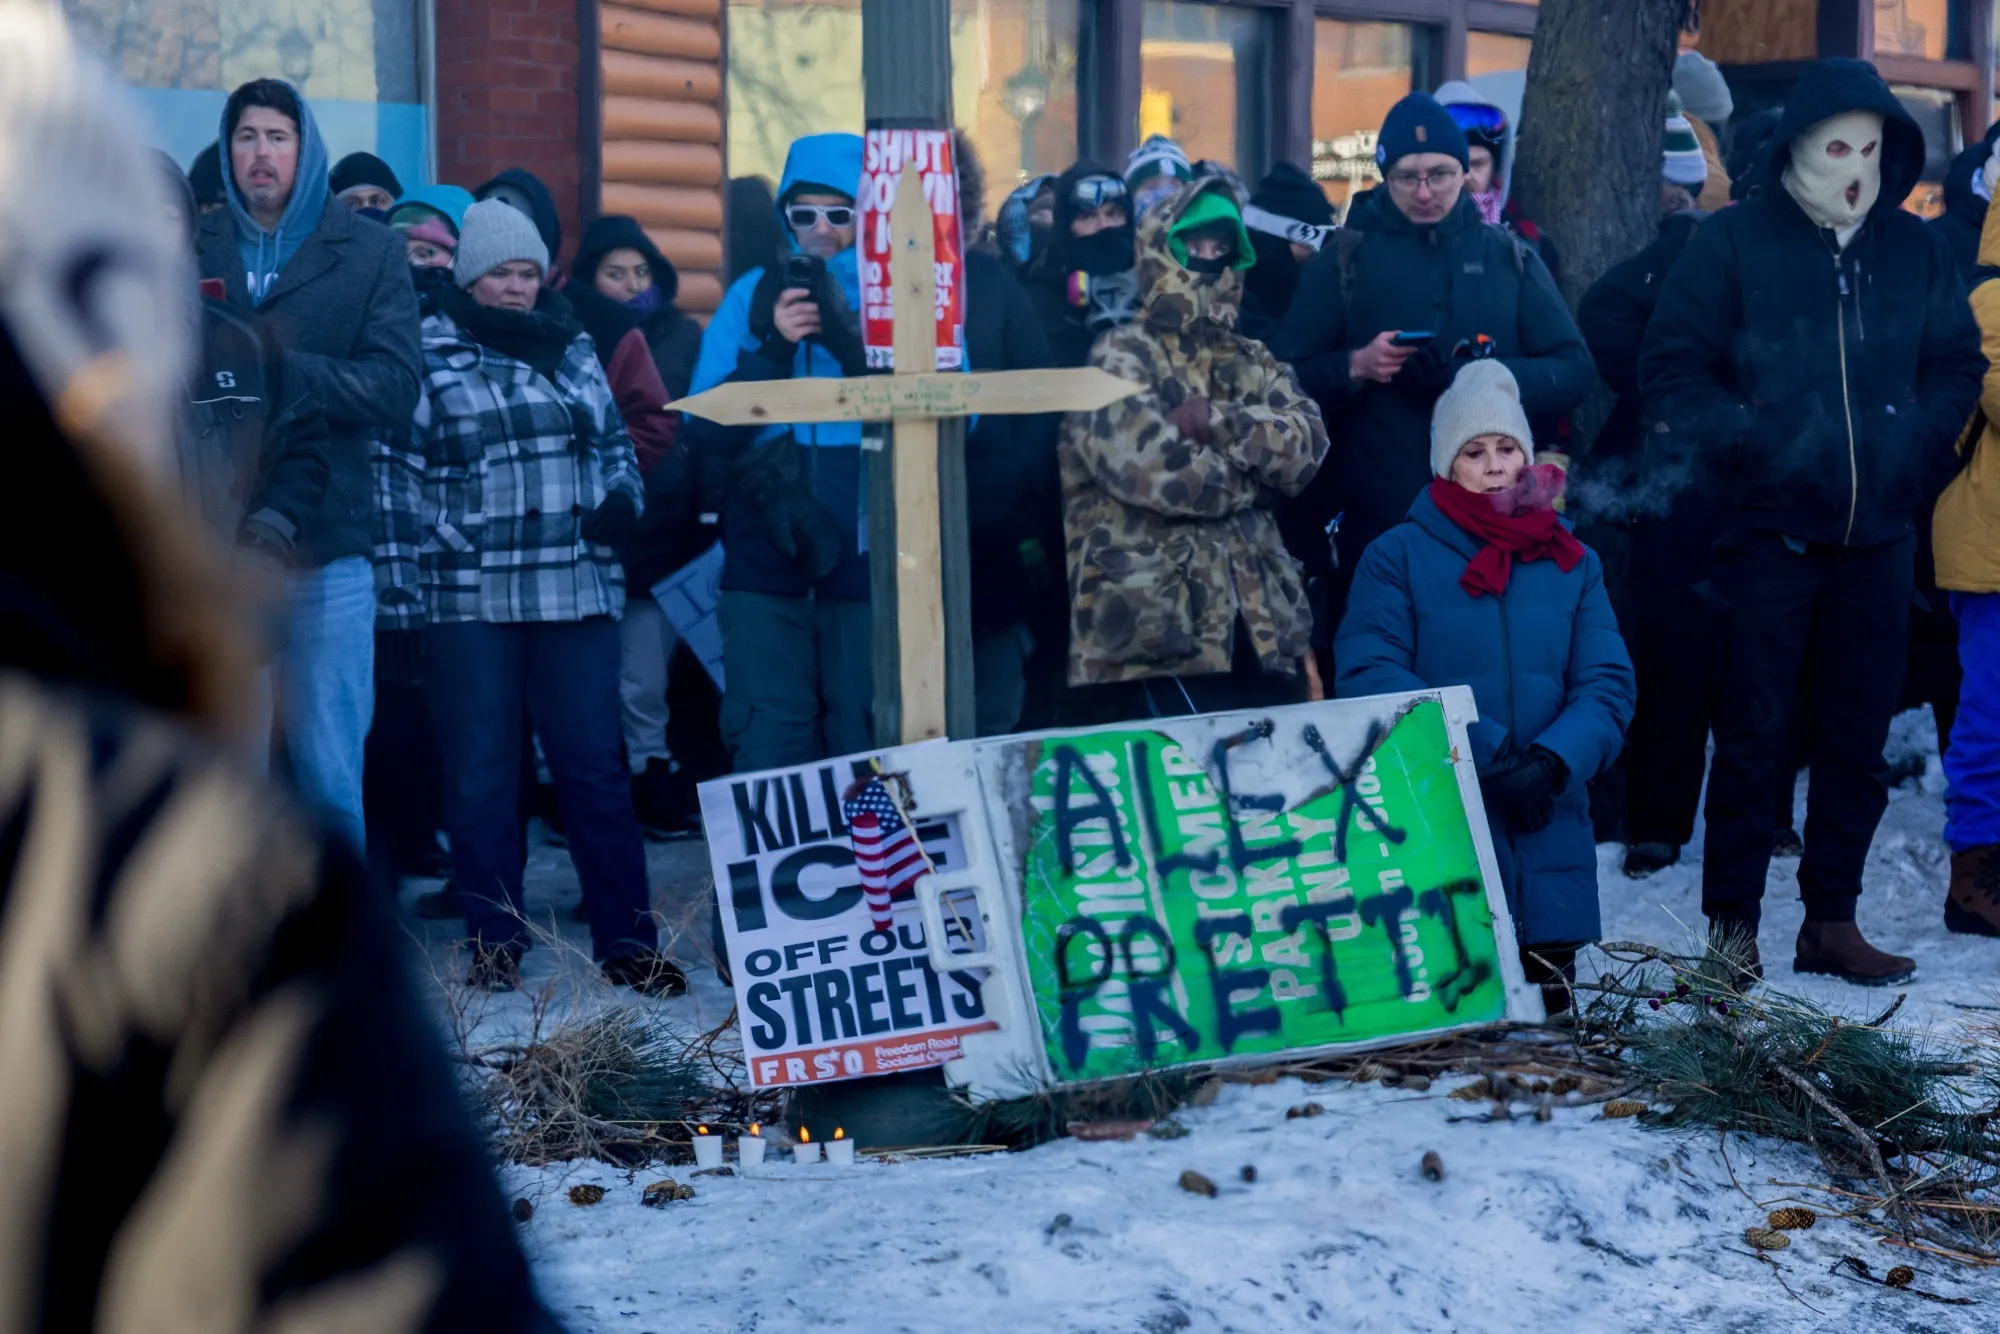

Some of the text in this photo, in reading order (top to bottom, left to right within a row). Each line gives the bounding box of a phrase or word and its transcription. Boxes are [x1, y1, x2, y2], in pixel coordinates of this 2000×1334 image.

[865, 129, 946, 172] SHUT
[731, 757, 878, 856] KILL
[1053, 716, 1408, 888] ALEX
[744, 916, 975, 977] OFF OUR
[1054, 876, 1493, 1072] PRETTI
[746, 948, 988, 1051] STREETS
[874, 1034, 958, 1058] Freedom Road
